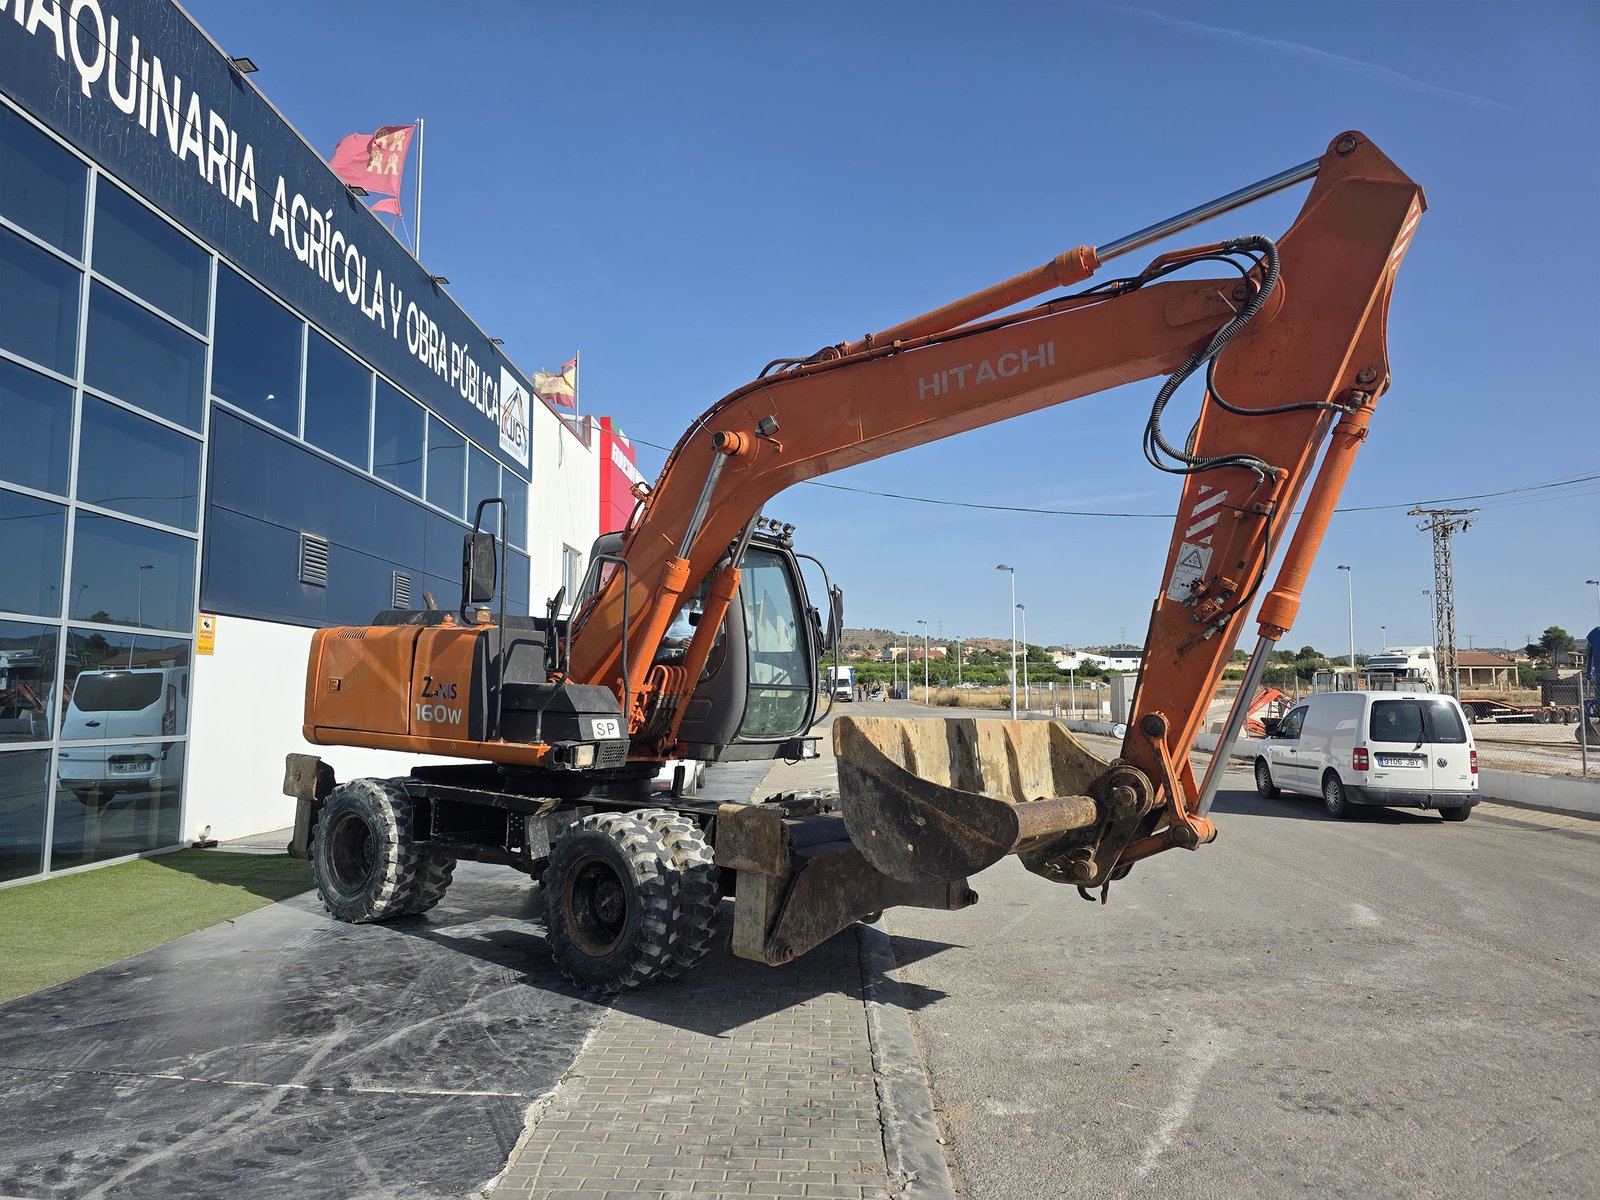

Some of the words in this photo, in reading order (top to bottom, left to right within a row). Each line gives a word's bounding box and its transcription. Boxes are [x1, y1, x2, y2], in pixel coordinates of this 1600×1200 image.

[0, 0, 259, 222] AQUINARIA
[269, 175, 386, 329] AGRÍCOLA
[390, 282, 403, 339] Y
[406, 301, 449, 382] OBRA
[451, 341, 500, 426] PÚBLICA
[918, 341, 1055, 400] HITACHI
[415, 703, 462, 725] 160W
[596, 722, 615, 736] SP
[1383, 758, 1403, 766] 9106
